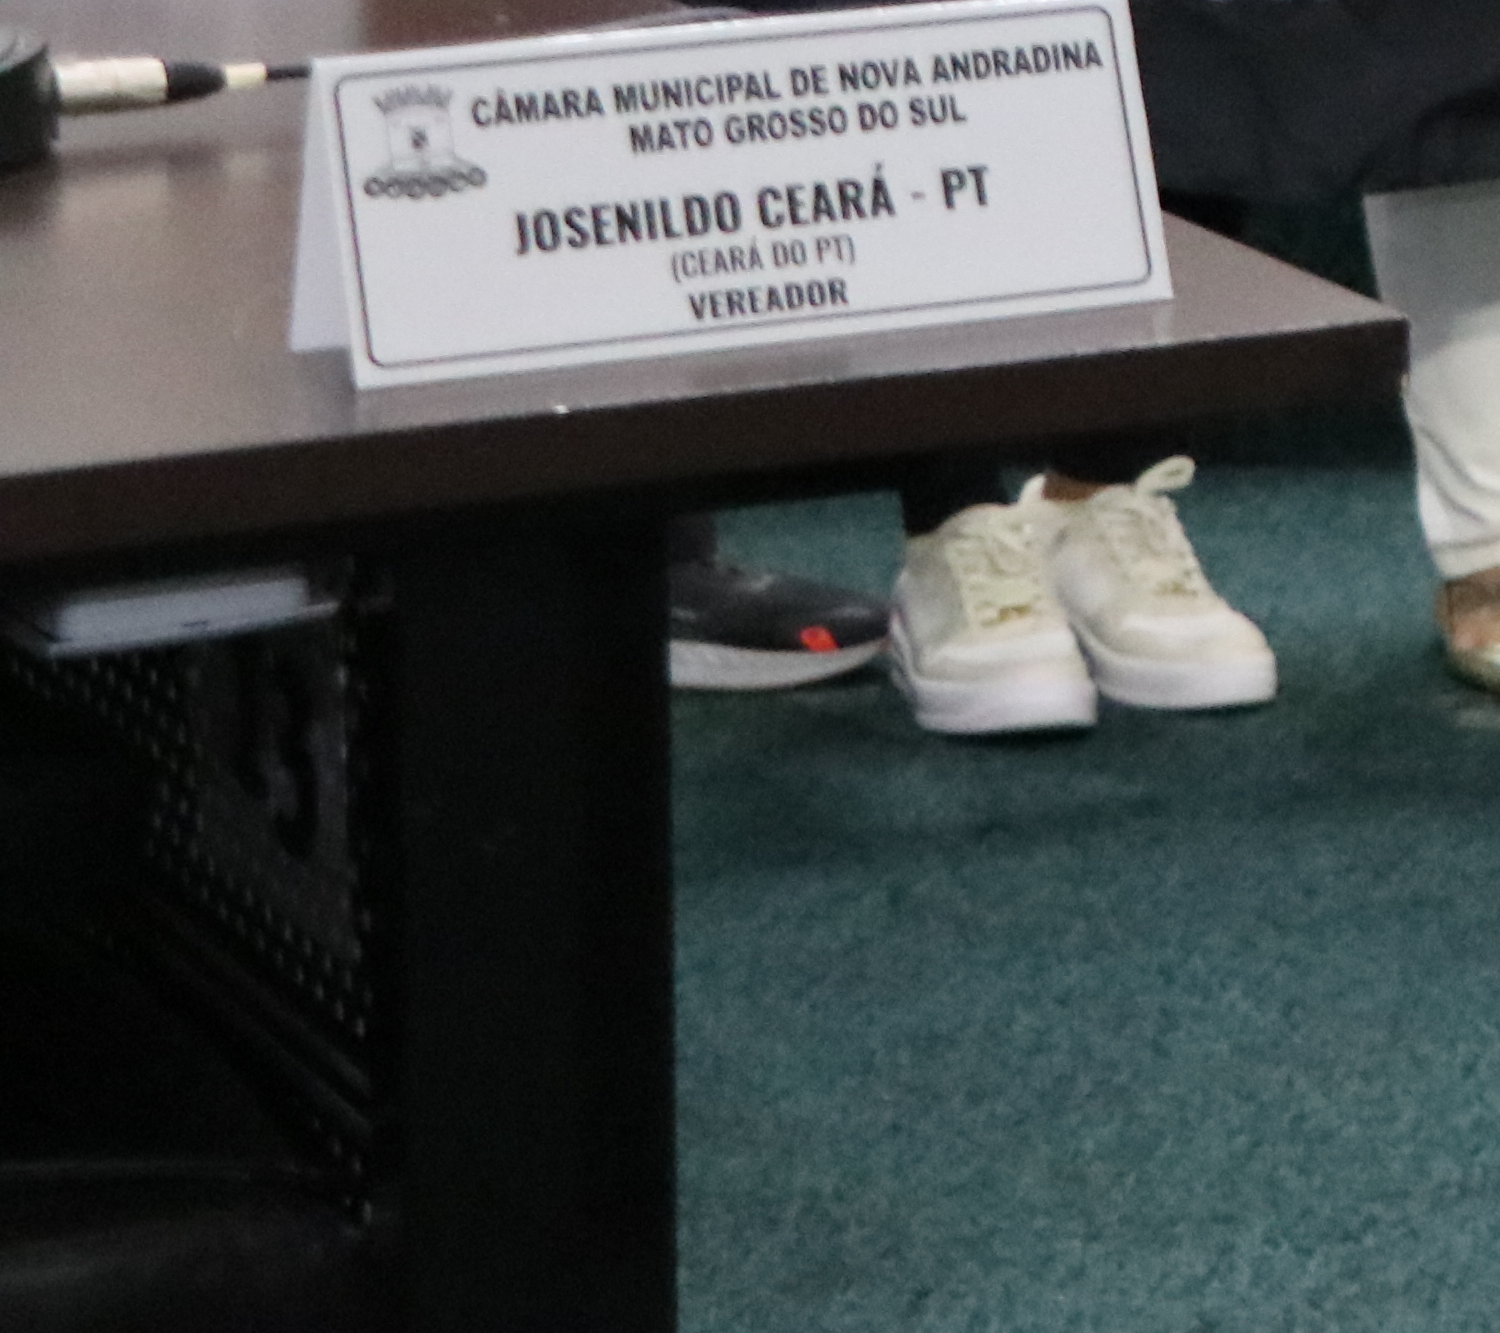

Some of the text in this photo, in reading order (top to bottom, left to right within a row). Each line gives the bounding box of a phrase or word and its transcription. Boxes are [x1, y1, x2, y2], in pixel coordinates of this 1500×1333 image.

[471, 38, 1105, 128] CÂMARA MUNICIPAL DE NOVA ANDRADINA
[629, 93, 968, 155] MATO GROSSO DO SUL
[515, 189, 743, 256] JOSENILDO
[757, 162, 896, 231] CEARÁ
[940, 165, 990, 211] PT
[670, 232, 857, 284] (CEARÁ DO PT)
[689, 277, 850, 322] VEREADOR
